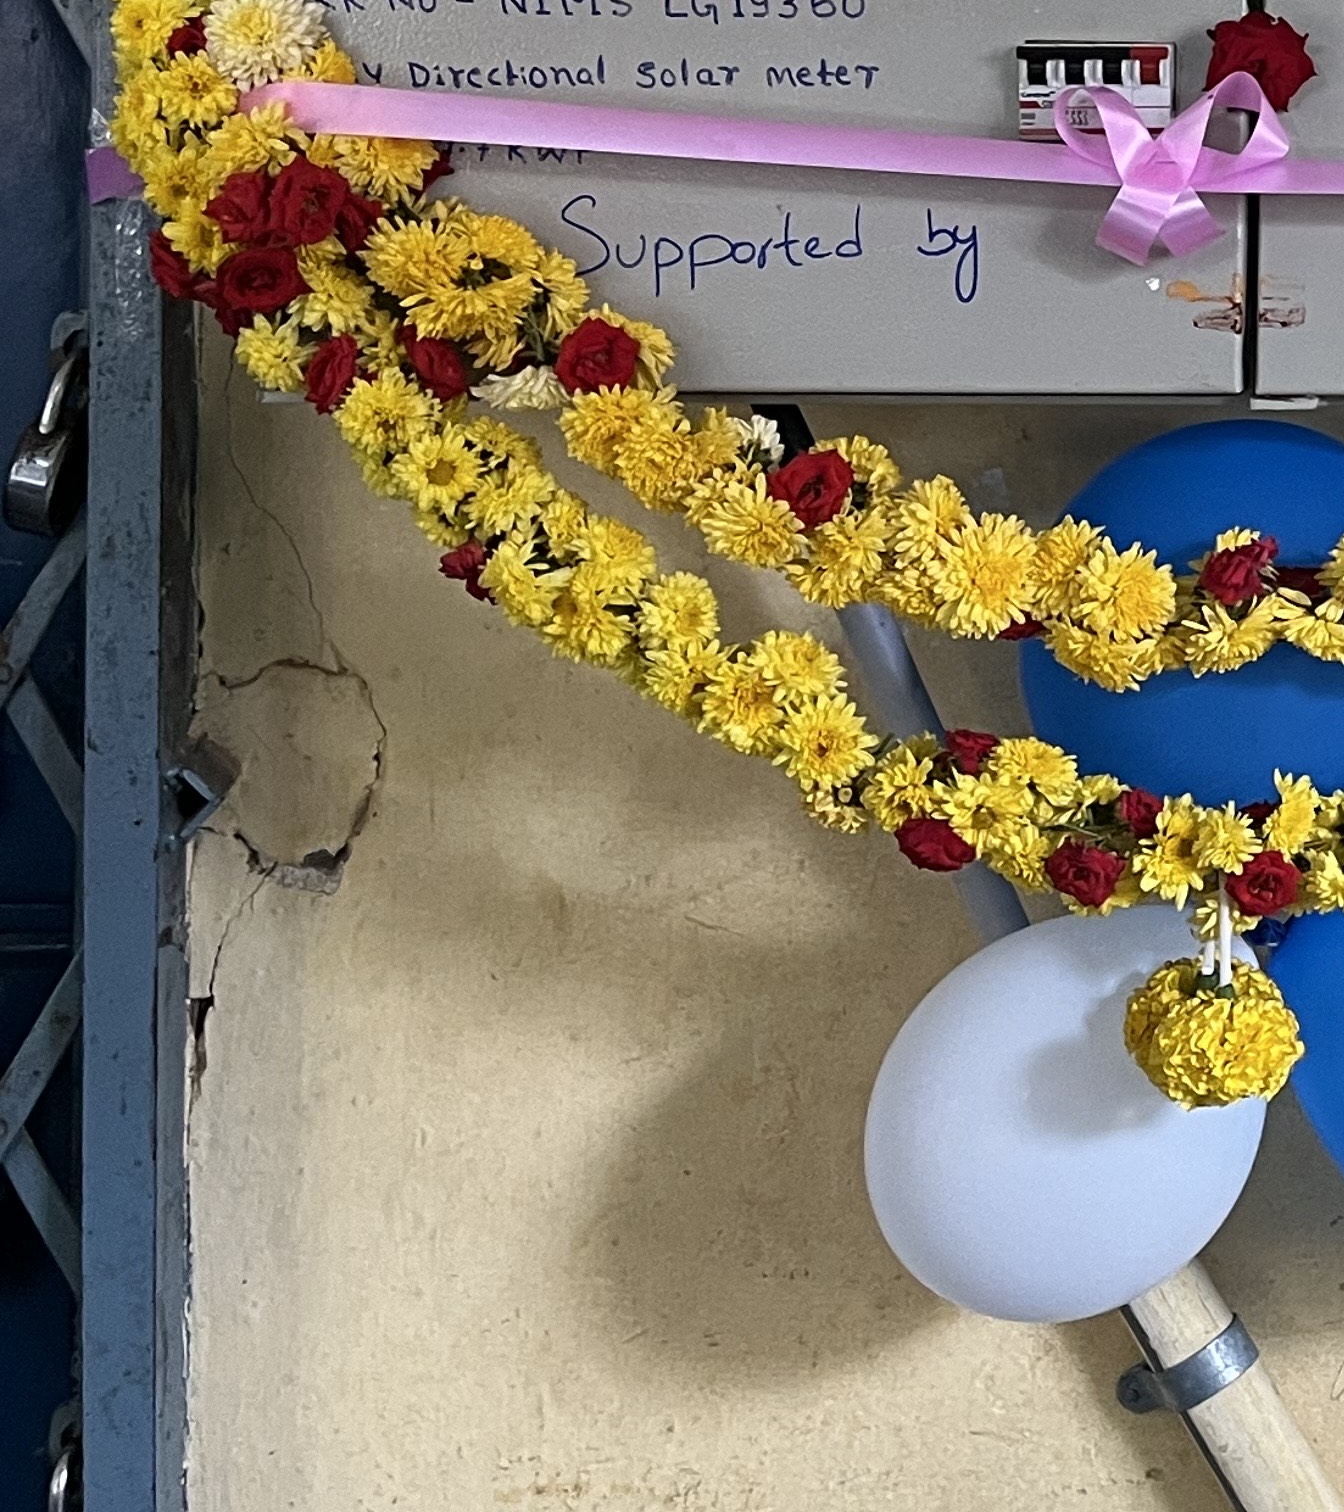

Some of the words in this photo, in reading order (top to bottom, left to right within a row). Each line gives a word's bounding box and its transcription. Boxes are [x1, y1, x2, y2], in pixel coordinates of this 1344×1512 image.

[408, 54, 605, 89] Directional
[561, 194, 862, 297] Supported
[917, 207, 979, 303] by
